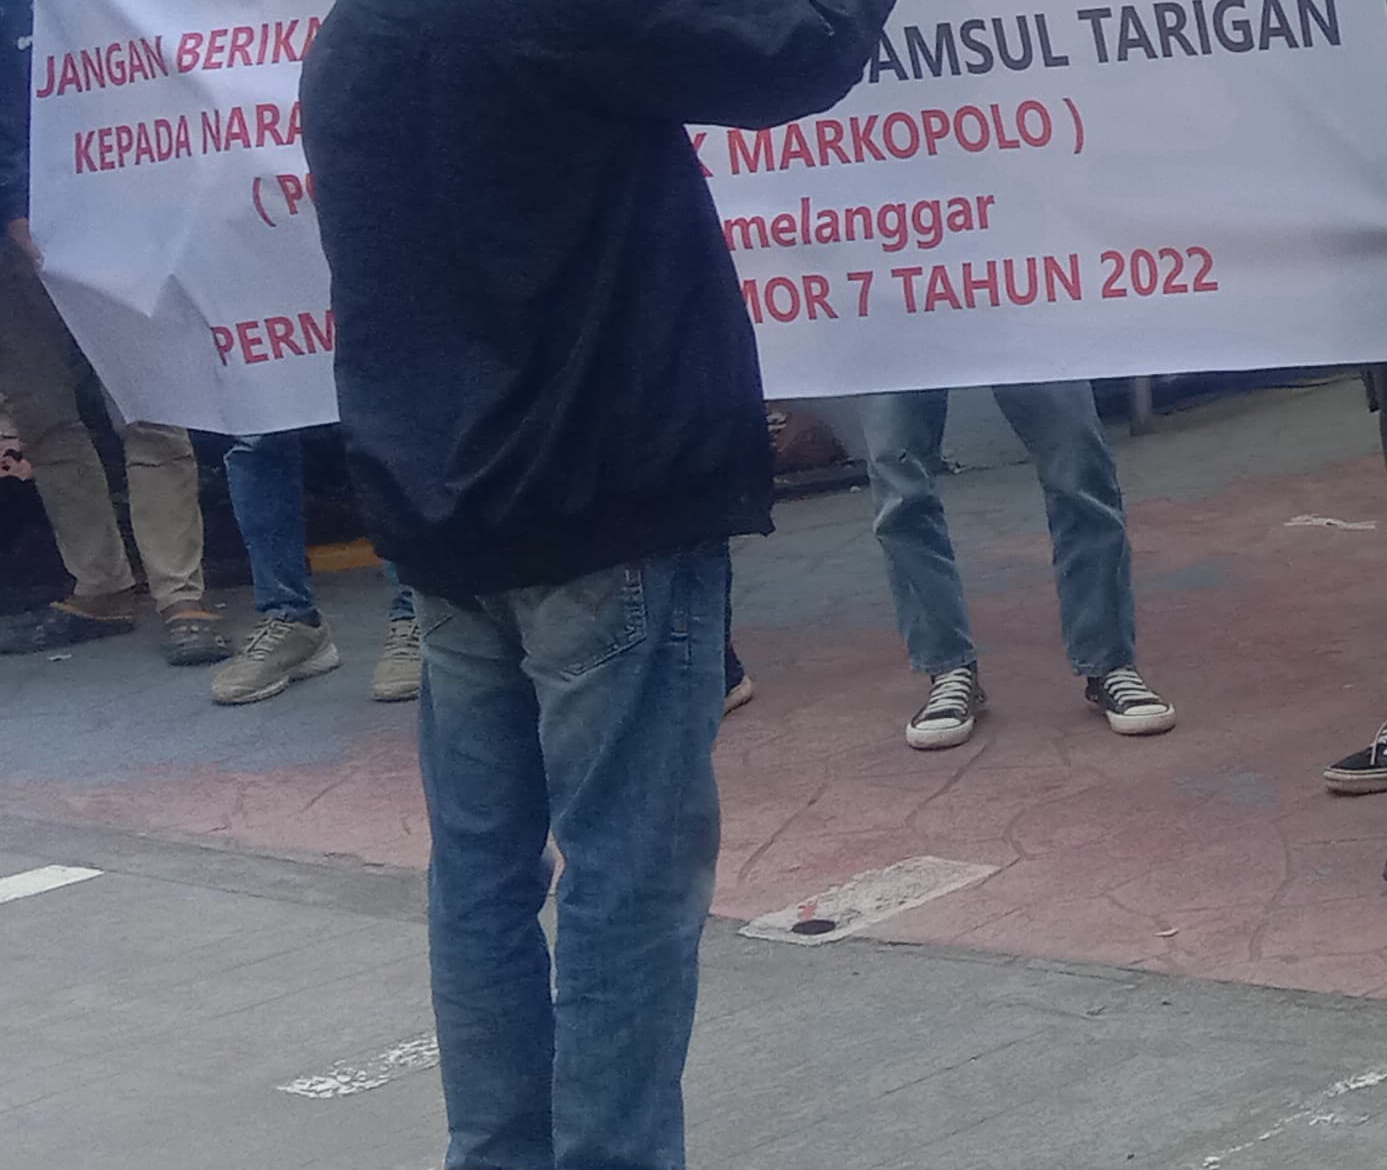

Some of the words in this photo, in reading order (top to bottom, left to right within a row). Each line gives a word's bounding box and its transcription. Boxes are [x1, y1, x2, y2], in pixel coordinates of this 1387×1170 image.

[36, 36, 170, 99] JANGAN
[868, 13, 1069, 84] AMSUL
[75, 114, 192, 175] KEPADA
[723, 191, 995, 252] melanggar
[848, 270, 873, 318] 7
[891, 254, 1083, 313] TAHUN
[1101, 245, 1219, 301] 2022
